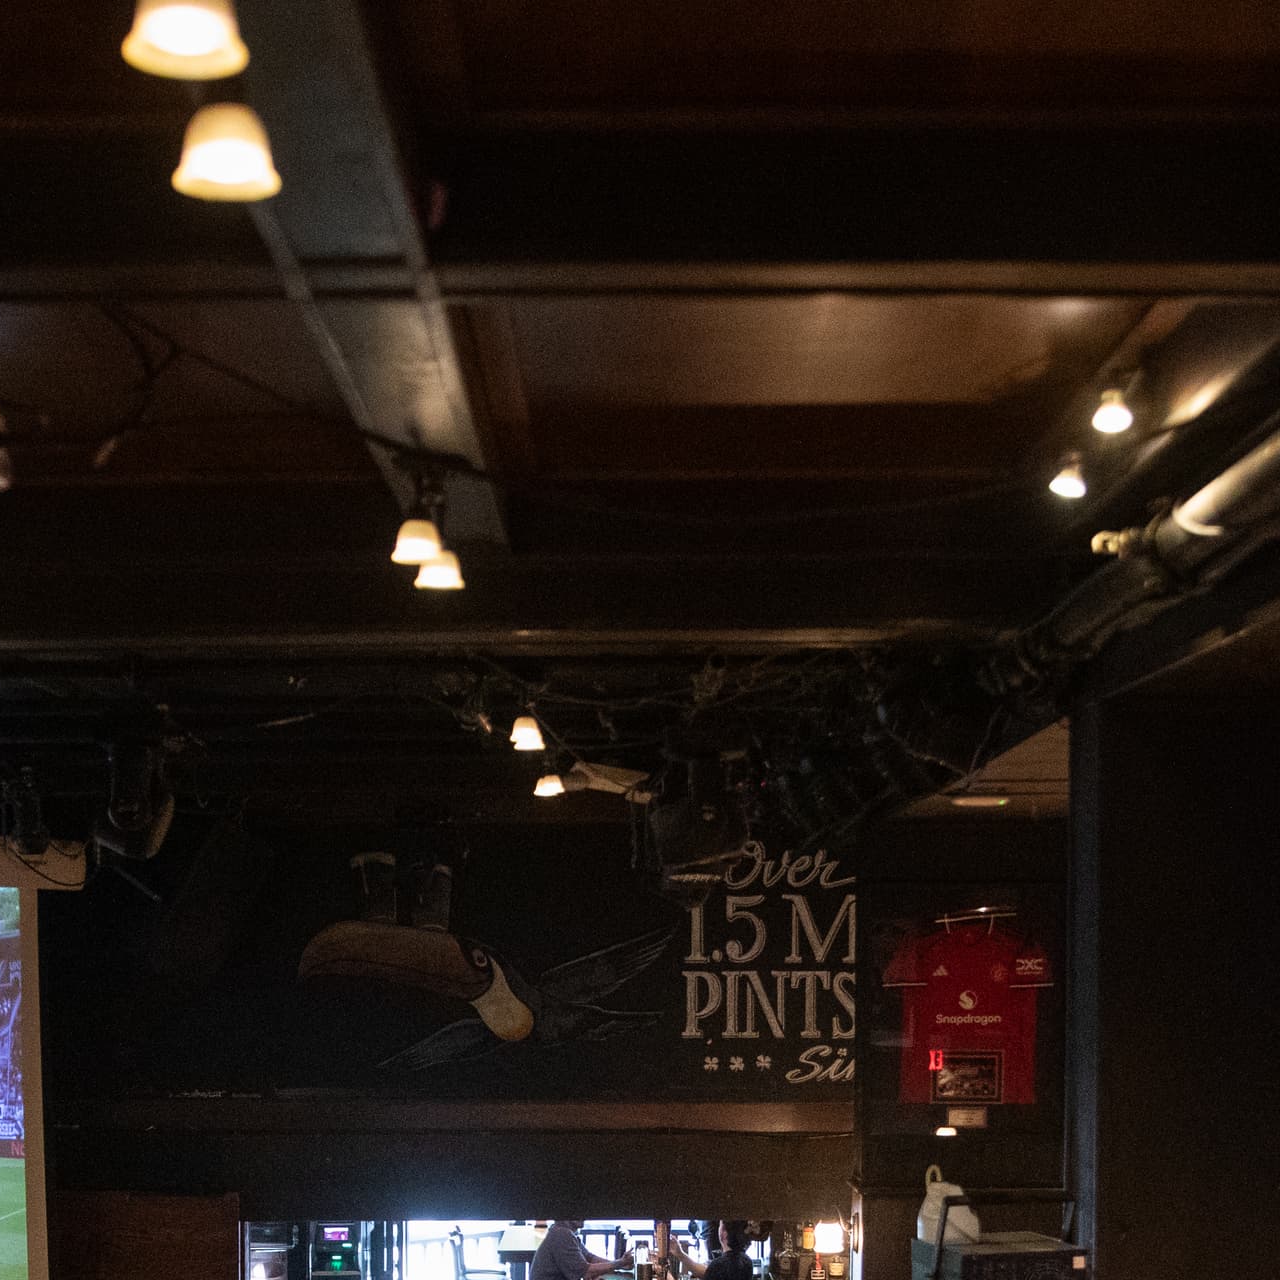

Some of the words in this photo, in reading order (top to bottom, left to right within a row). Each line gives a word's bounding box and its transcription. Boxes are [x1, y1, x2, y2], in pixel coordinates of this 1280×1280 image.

[724, 840, 856, 890] Over
[684, 894, 767, 964] 1.5
[681, 970, 856, 1039] PINTS
[935, 1013, 1003, 1026] Snapdragon
